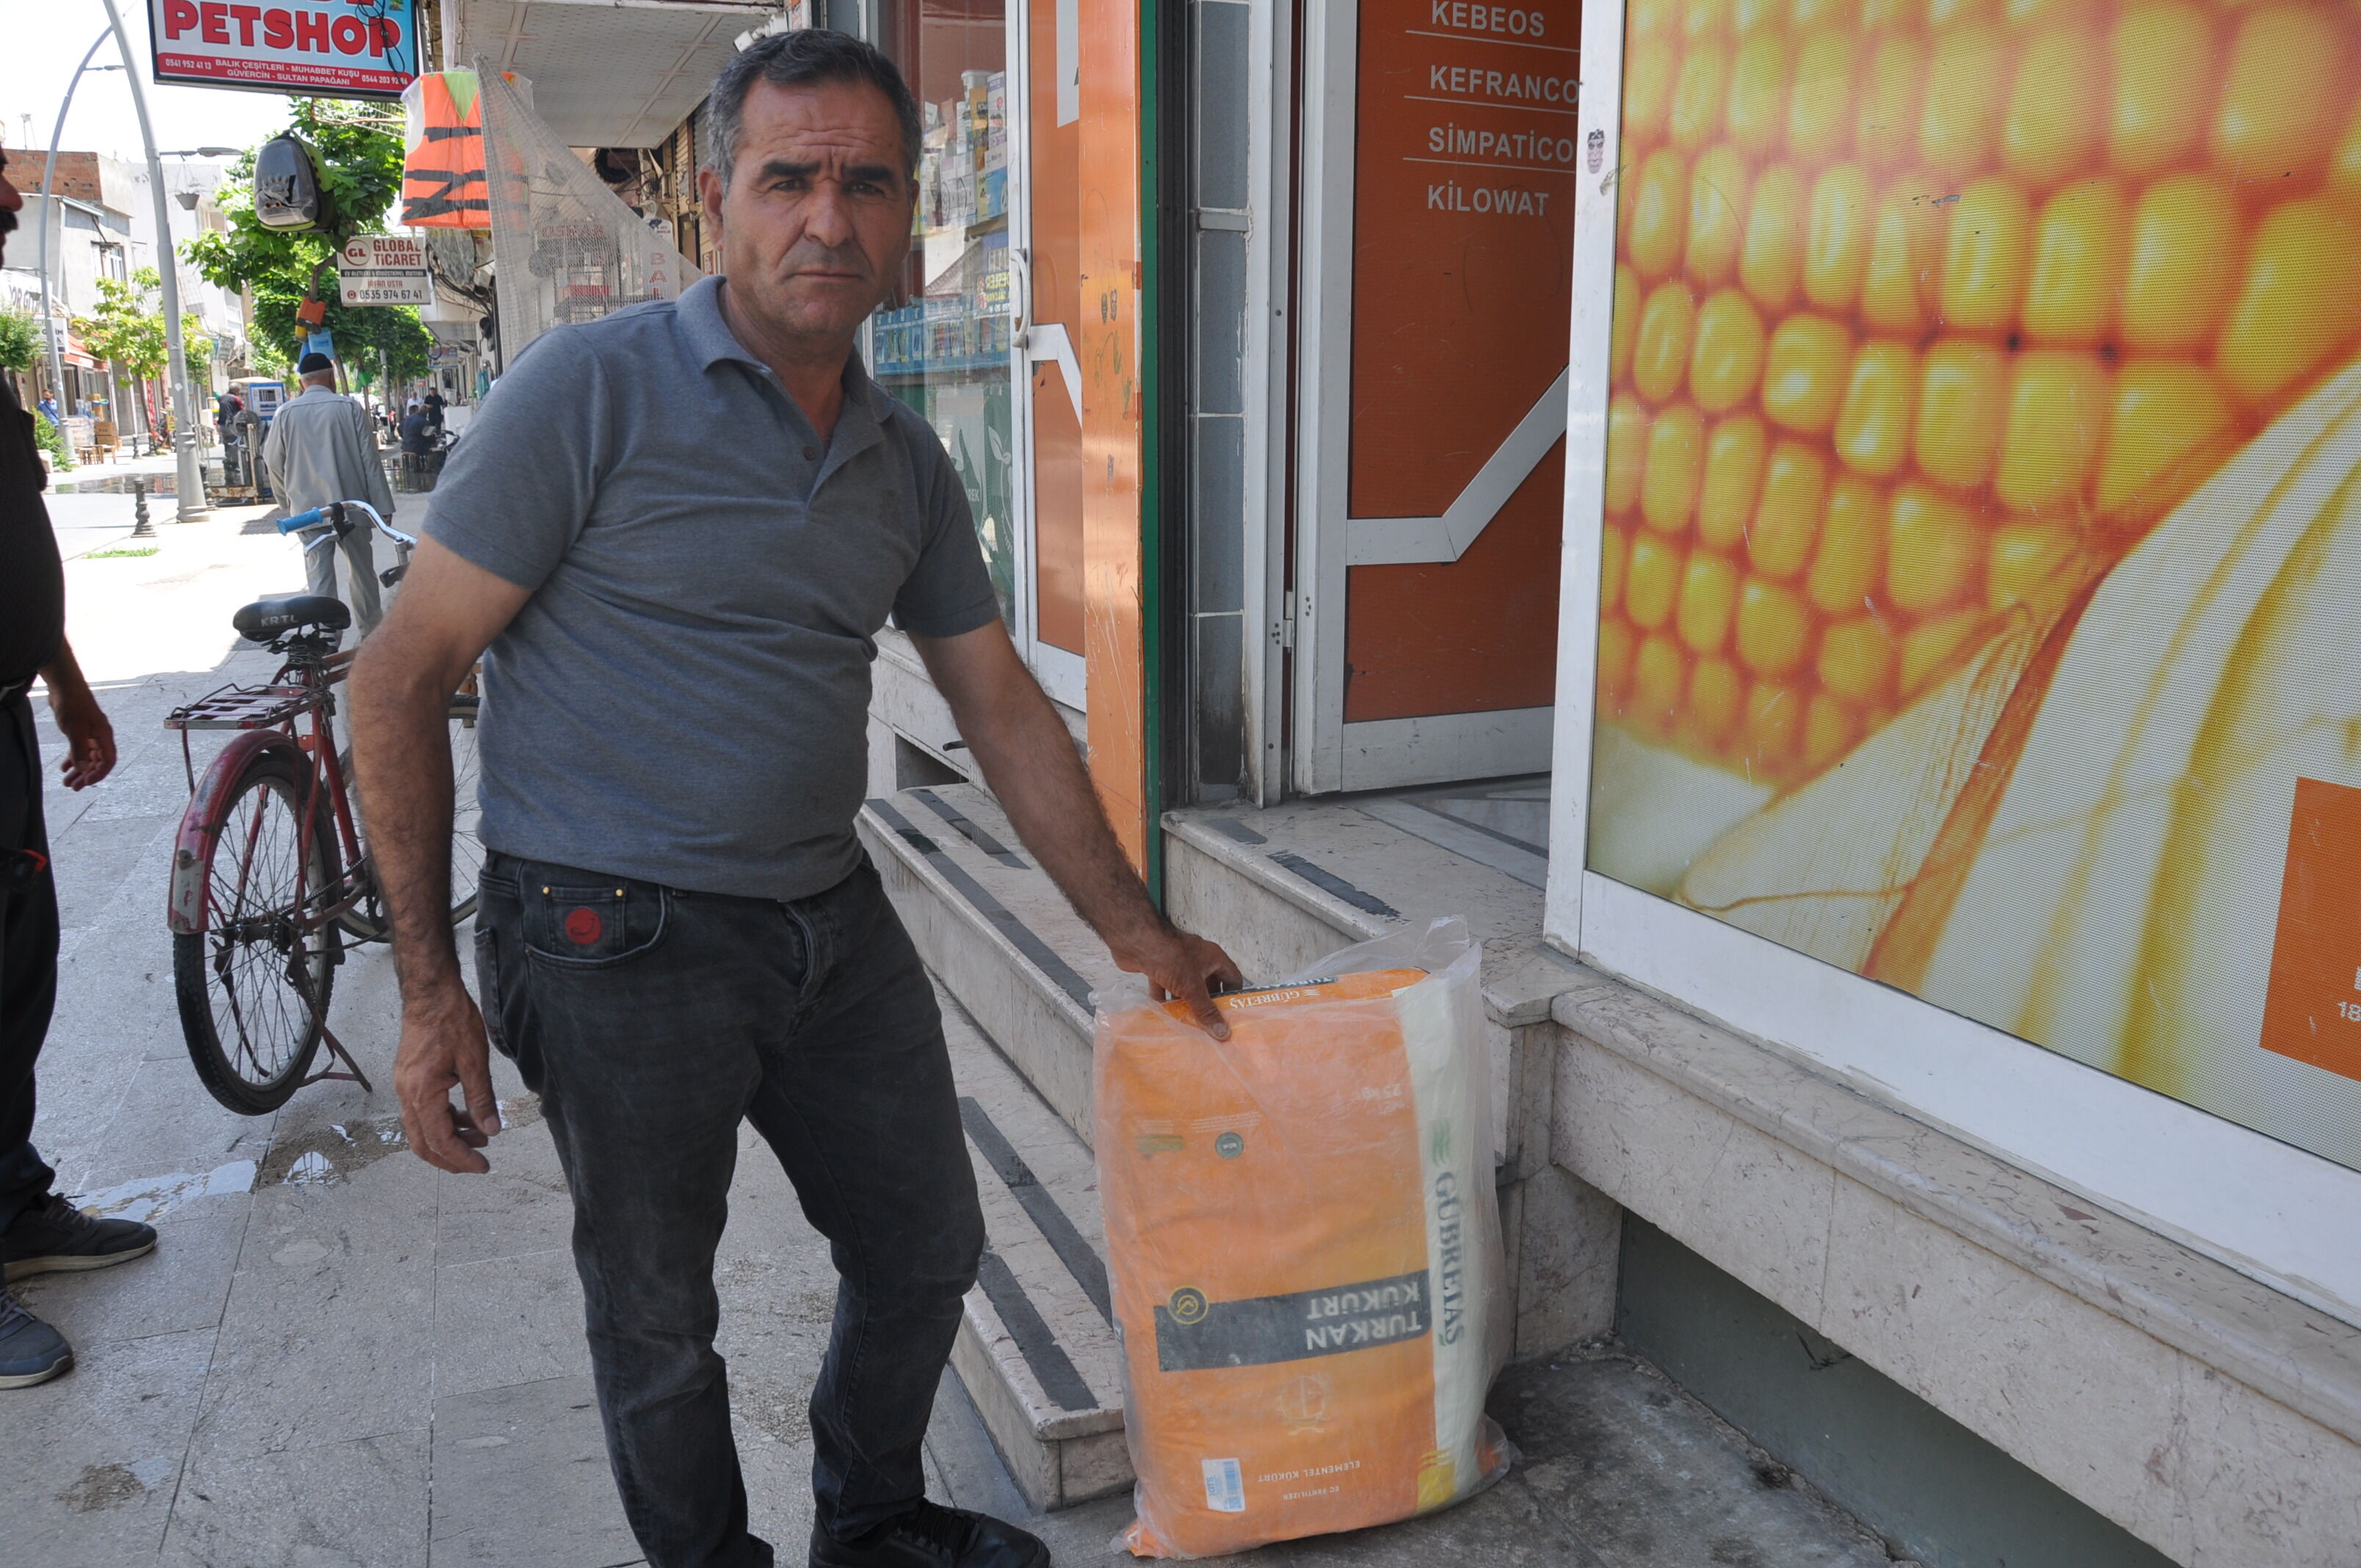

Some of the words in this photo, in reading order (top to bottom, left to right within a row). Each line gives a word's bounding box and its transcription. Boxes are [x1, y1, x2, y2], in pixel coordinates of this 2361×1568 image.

[1432, 0, 1545, 37] KEBEOS
[163, 0, 401, 57] PETSHOP
[165, 58, 181, 68] 0541
[182, 60, 195, 69] 952
[196, 61, 203, 70] 41
[216, 59, 240, 68] BALIK
[242, 61, 285, 71] ÇEŞİTLERİ
[291, 66, 336, 76] MUHABBET
[338, 69, 360, 78] KUŞU
[227, 69, 270, 79] GÜVERCİN
[277, 73, 308, 83] SULTAN
[310, 76, 350, 85] PAPAĞANI
[1430, 65, 1579, 104] KEFRANCO
[1429, 122, 1573, 163] SİMPATİCO
[1428, 180, 1549, 216] KİLOWAT
[347, 248, 366, 258] GL
[373, 239, 421, 252] GLOBAL
[387, 280, 403, 288] USTA
[360, 289, 380, 300] 0535
[382, 290, 399, 300] 974
[401, 290, 411, 300] 67
[413, 290, 422, 300] 41
[1230, 990, 1300, 1009] GÜBRETAŞ
[1307, 1281, 1421, 1320] KÜKÜRT
[1305, 1311, 1422, 1350] TURKAN
[1257, 1470, 1299, 1482] KÜKÜRT
[1303, 1461, 1360, 1477] ELEMENTEL
[1329, 1485, 1340, 1494] EC
